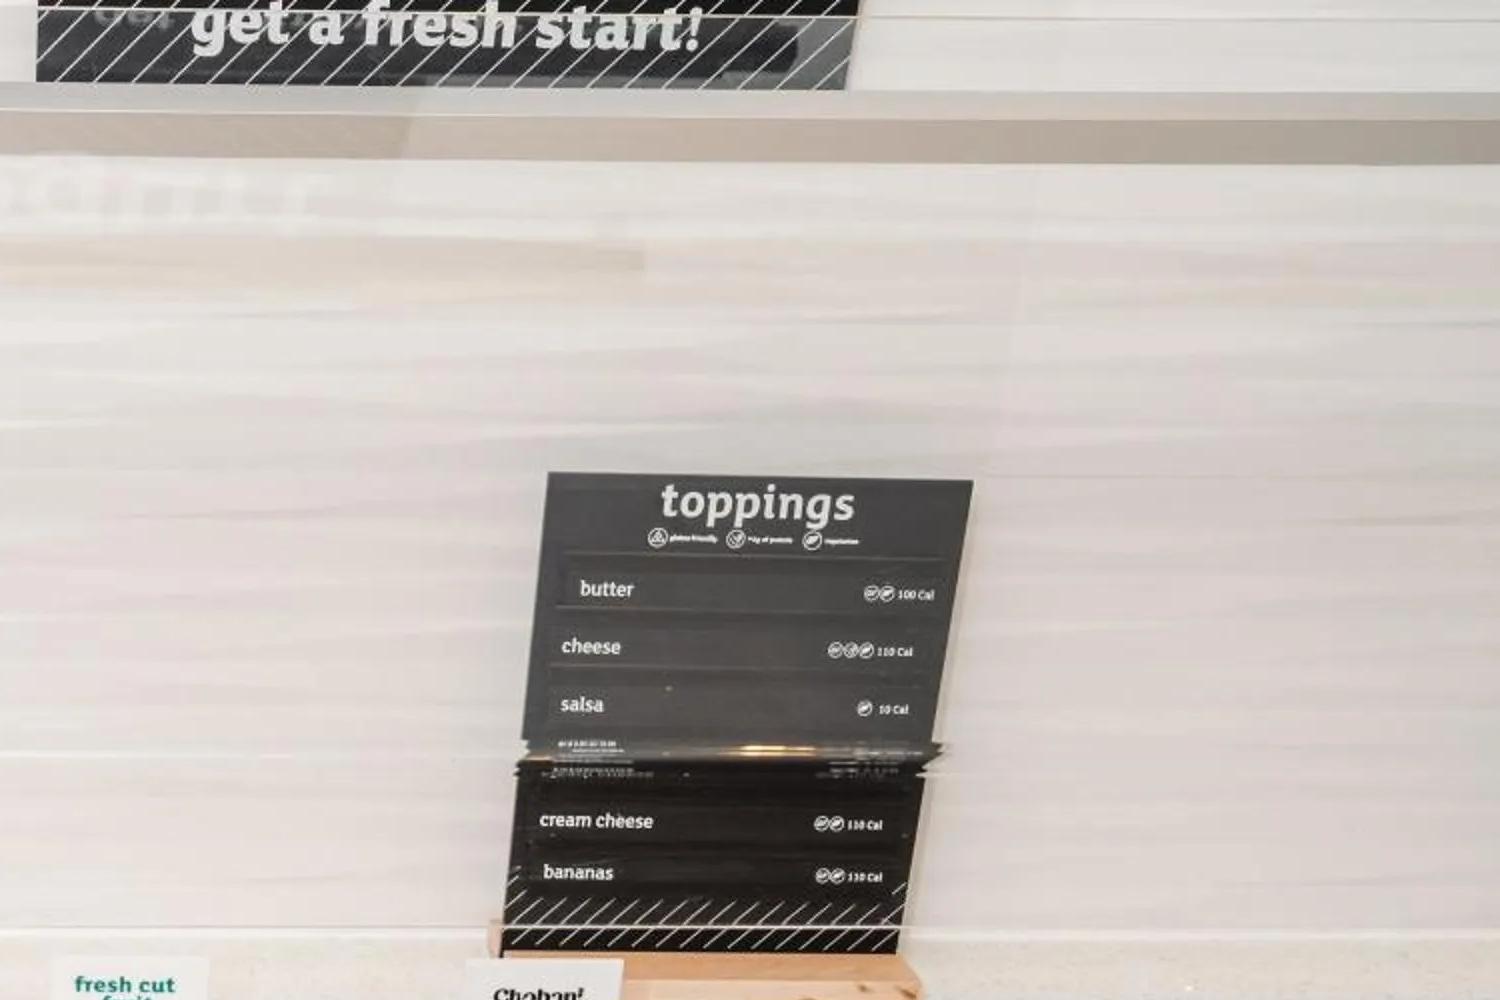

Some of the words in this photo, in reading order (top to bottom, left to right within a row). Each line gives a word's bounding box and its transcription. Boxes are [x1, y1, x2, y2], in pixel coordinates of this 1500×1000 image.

[191, 0, 290, 57] get
[308, 12, 345, 45] a
[361, 0, 517, 48] fresh
[534, 5, 703, 52] start!
[661, 484, 856, 530] toppings
[580, 579, 635, 597] butter
[917, 589, 936, 601] Cal
[561, 637, 622, 655] cheese
[897, 647, 914, 657] Cal
[560, 697, 605, 713] salsa
[893, 704, 909, 715] Cal
[539, 814, 592, 828] cream
[595, 812, 654, 829] cheese
[867, 820, 884, 831] Cal
[543, 864, 614, 881] bananas
[867, 872, 883, 883] Cal
[74, 976, 132, 993] fresh
[139, 978, 176, 993] cut
